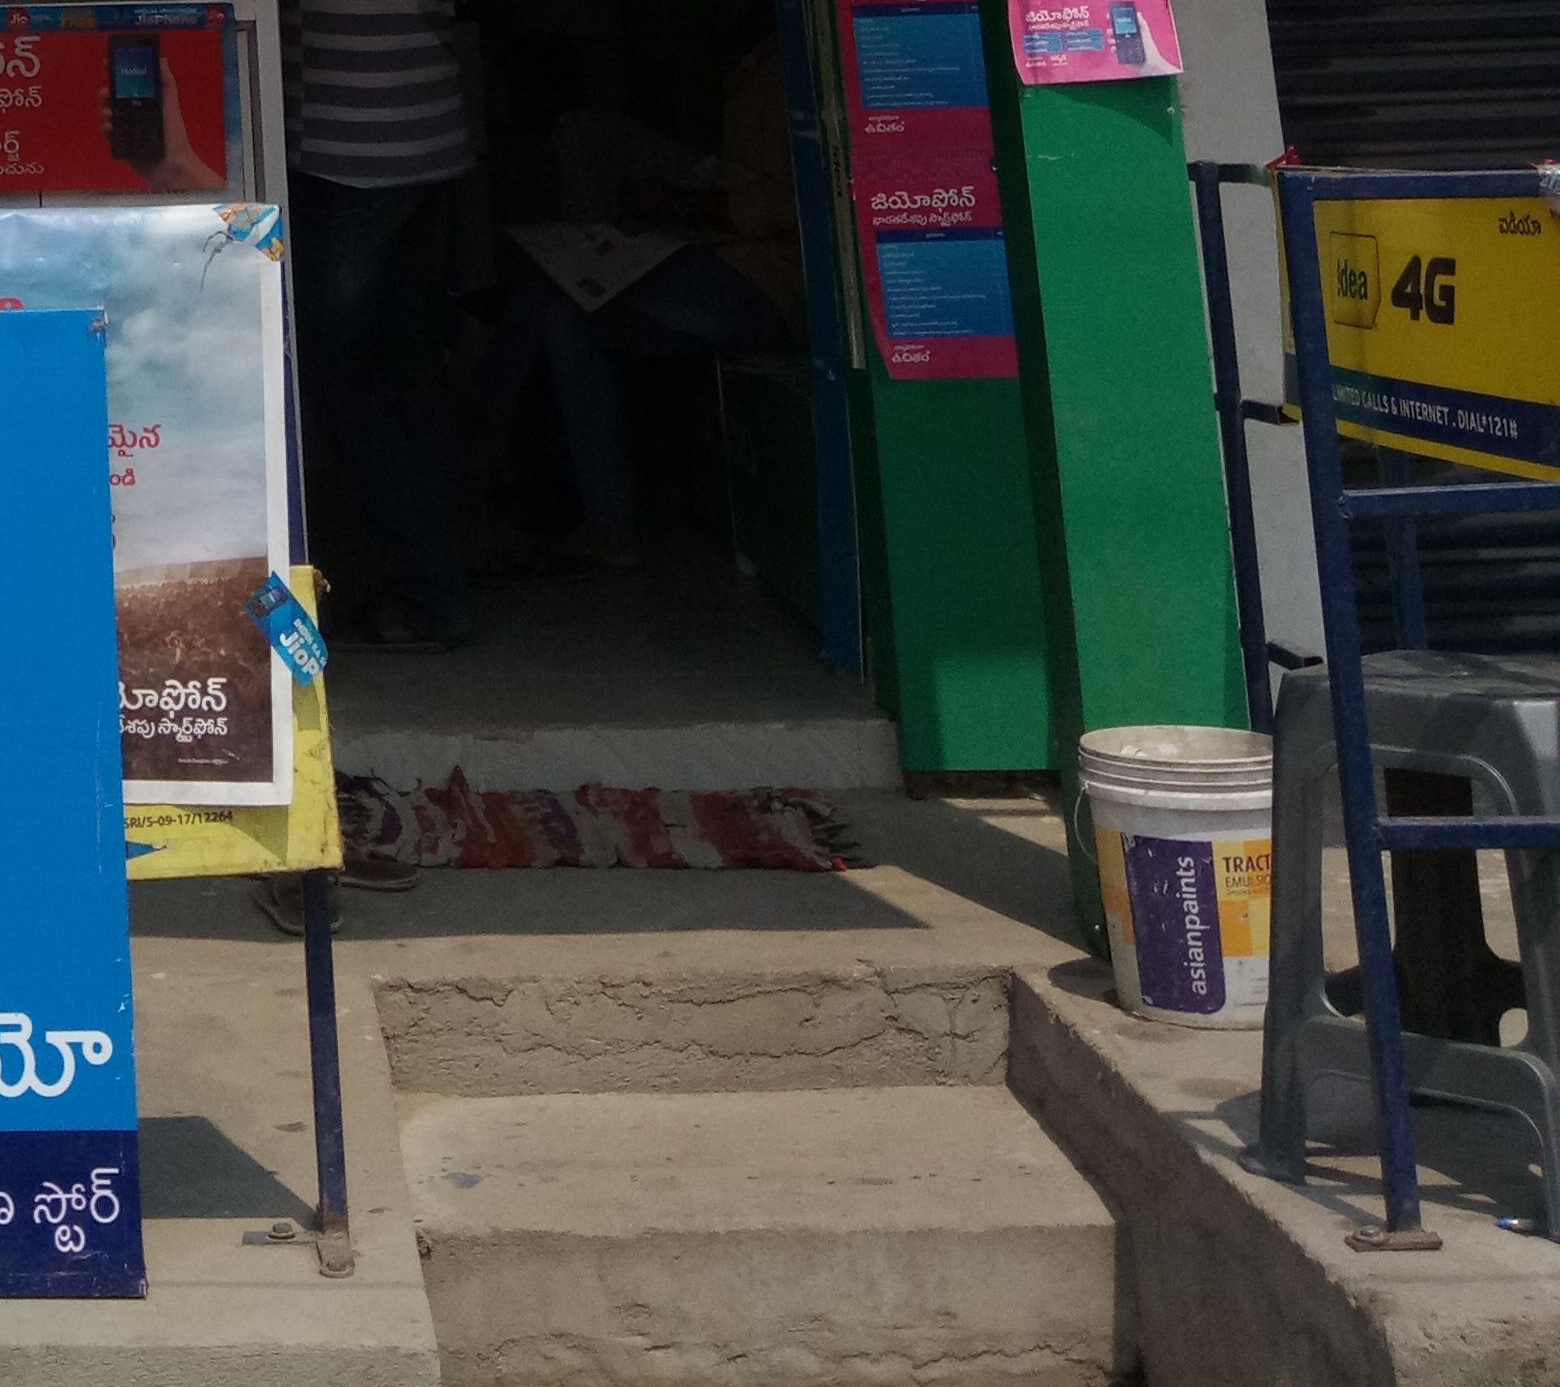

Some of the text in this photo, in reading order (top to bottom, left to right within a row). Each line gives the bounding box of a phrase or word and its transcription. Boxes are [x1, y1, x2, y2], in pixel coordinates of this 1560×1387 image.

[1390, 253, 1457, 326] 4G
[1361, 389, 1450, 426] CALLS INTERNET
[1174, 855, 1212, 997] asianpaints
[33, 1166, 122, 1255] స్టోర్
